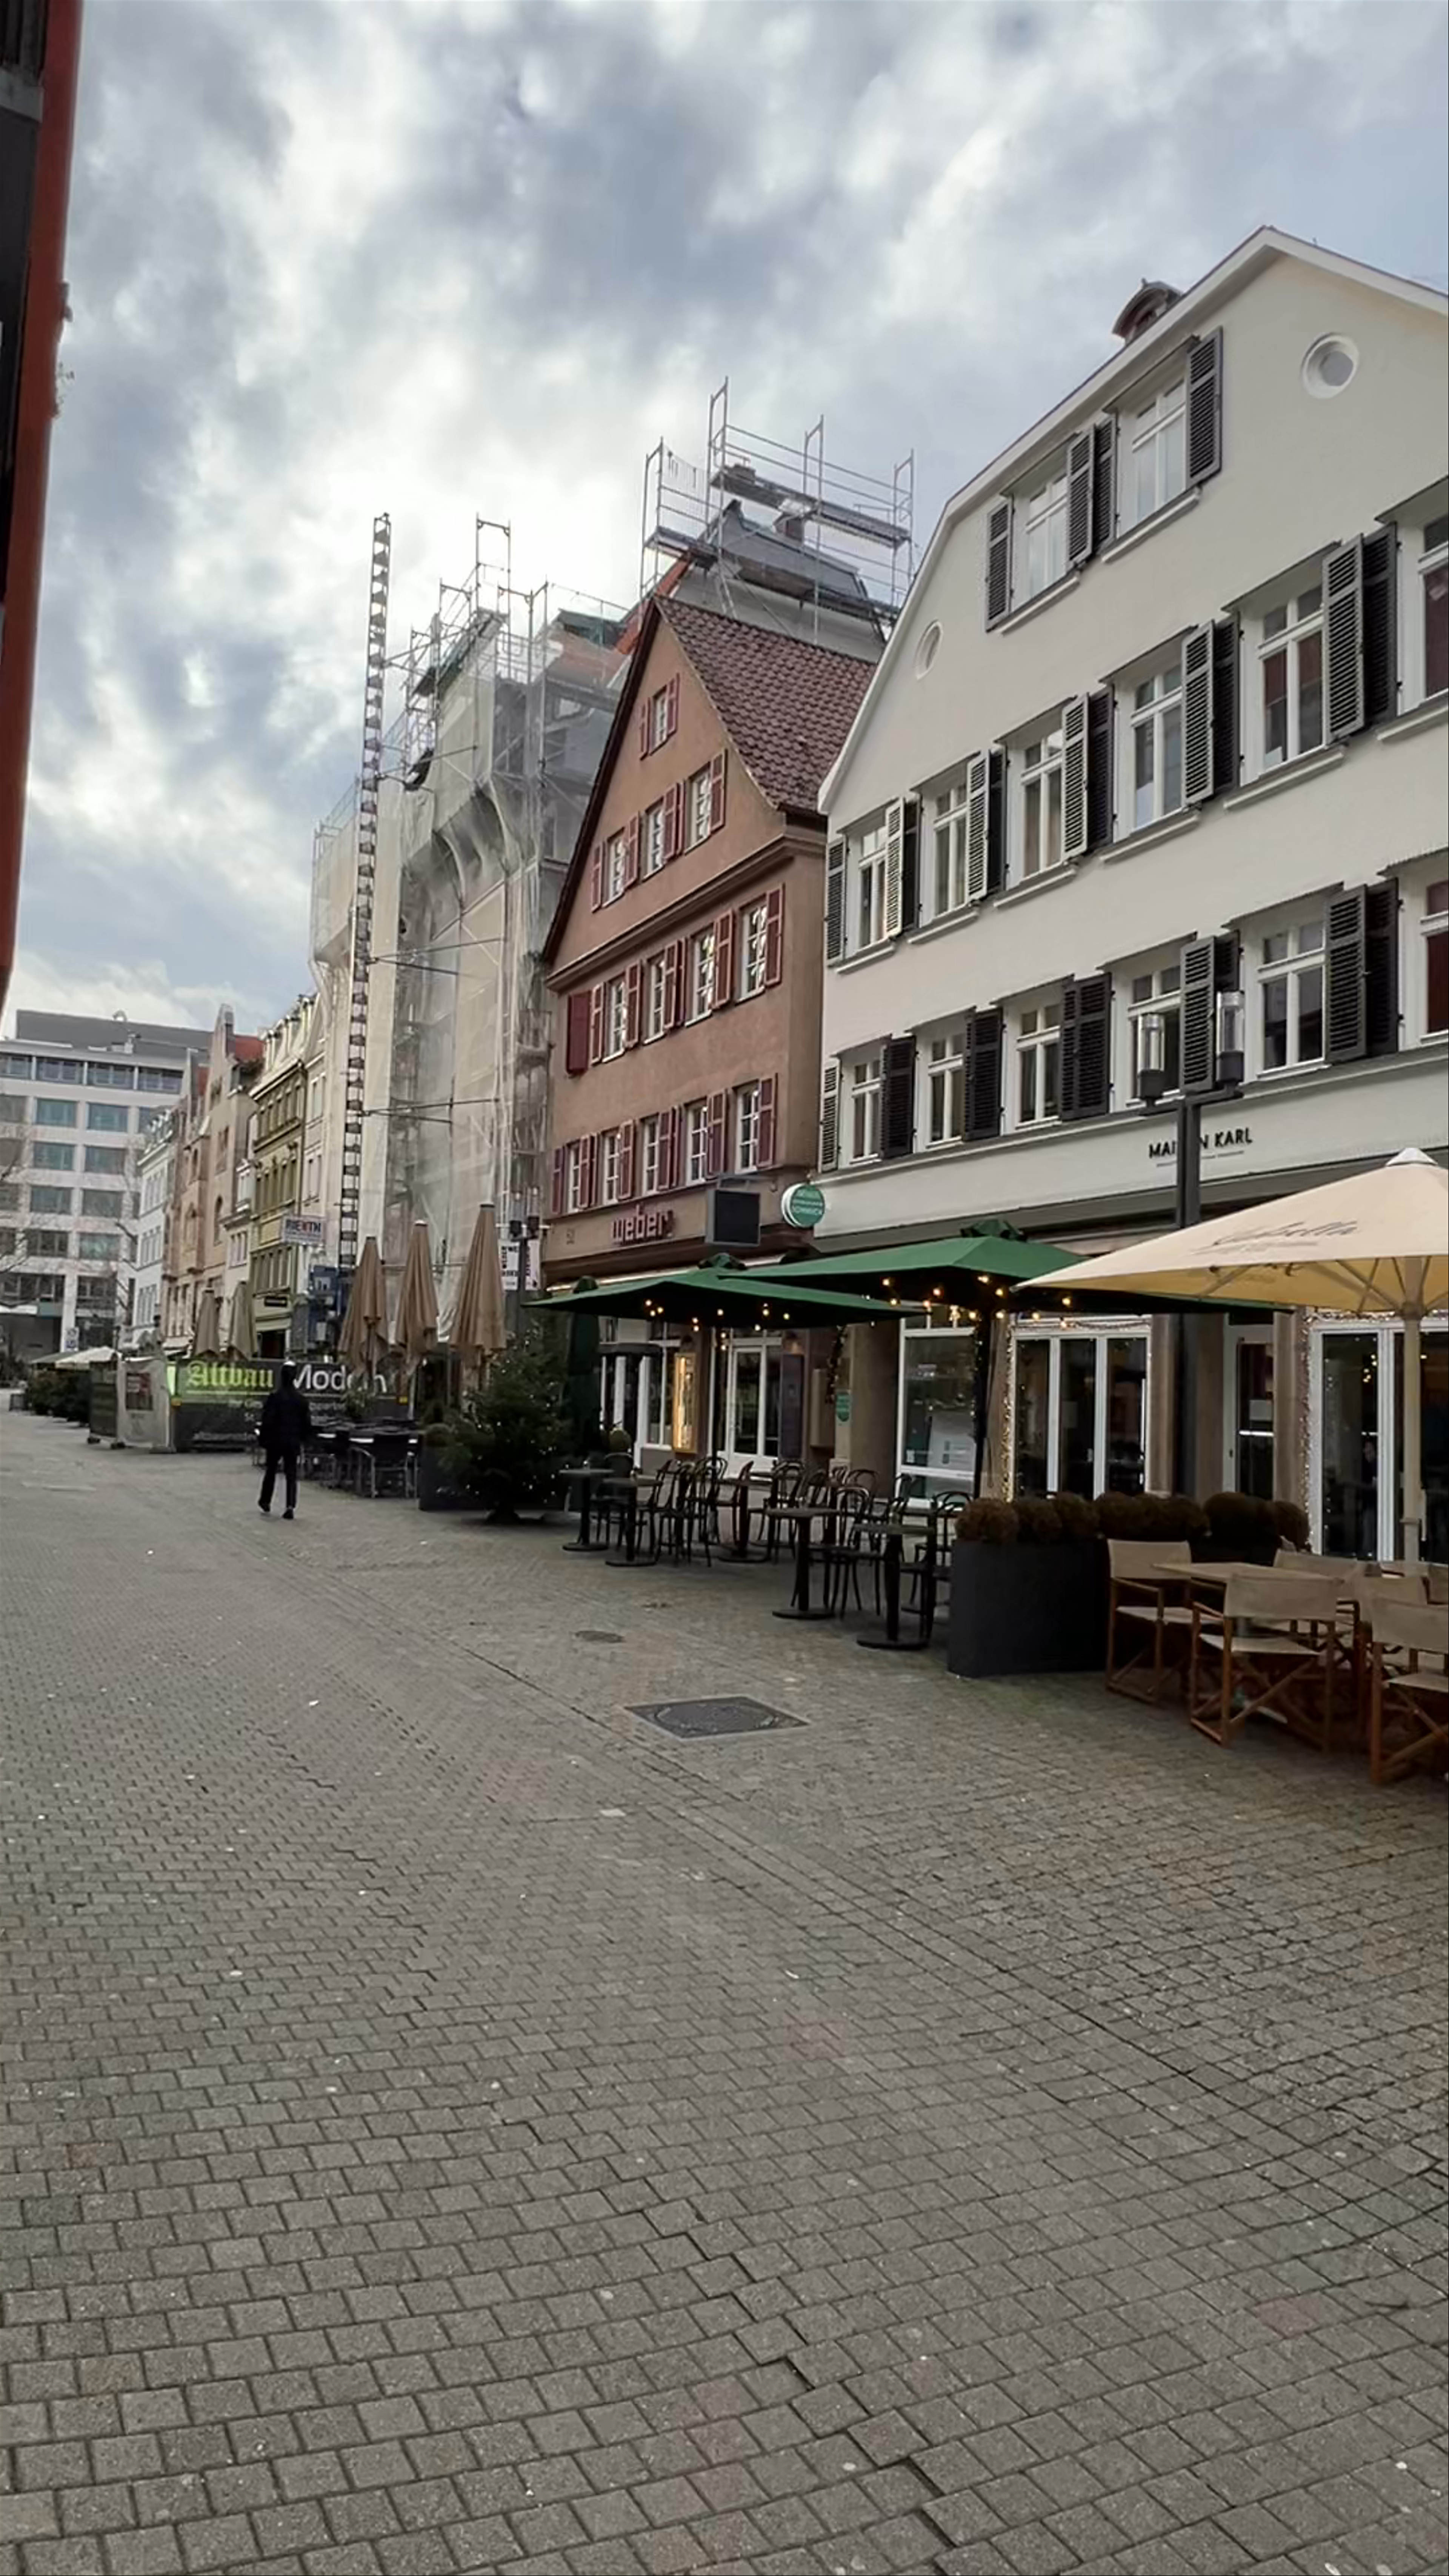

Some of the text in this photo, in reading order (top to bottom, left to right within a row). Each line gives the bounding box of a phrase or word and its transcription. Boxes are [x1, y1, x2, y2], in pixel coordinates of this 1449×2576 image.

[1149, 1134, 1209, 1158] MAIN
[1215, 1127, 1252, 1147] KARL
[187, 1360, 388, 1393] Altbau Modn
